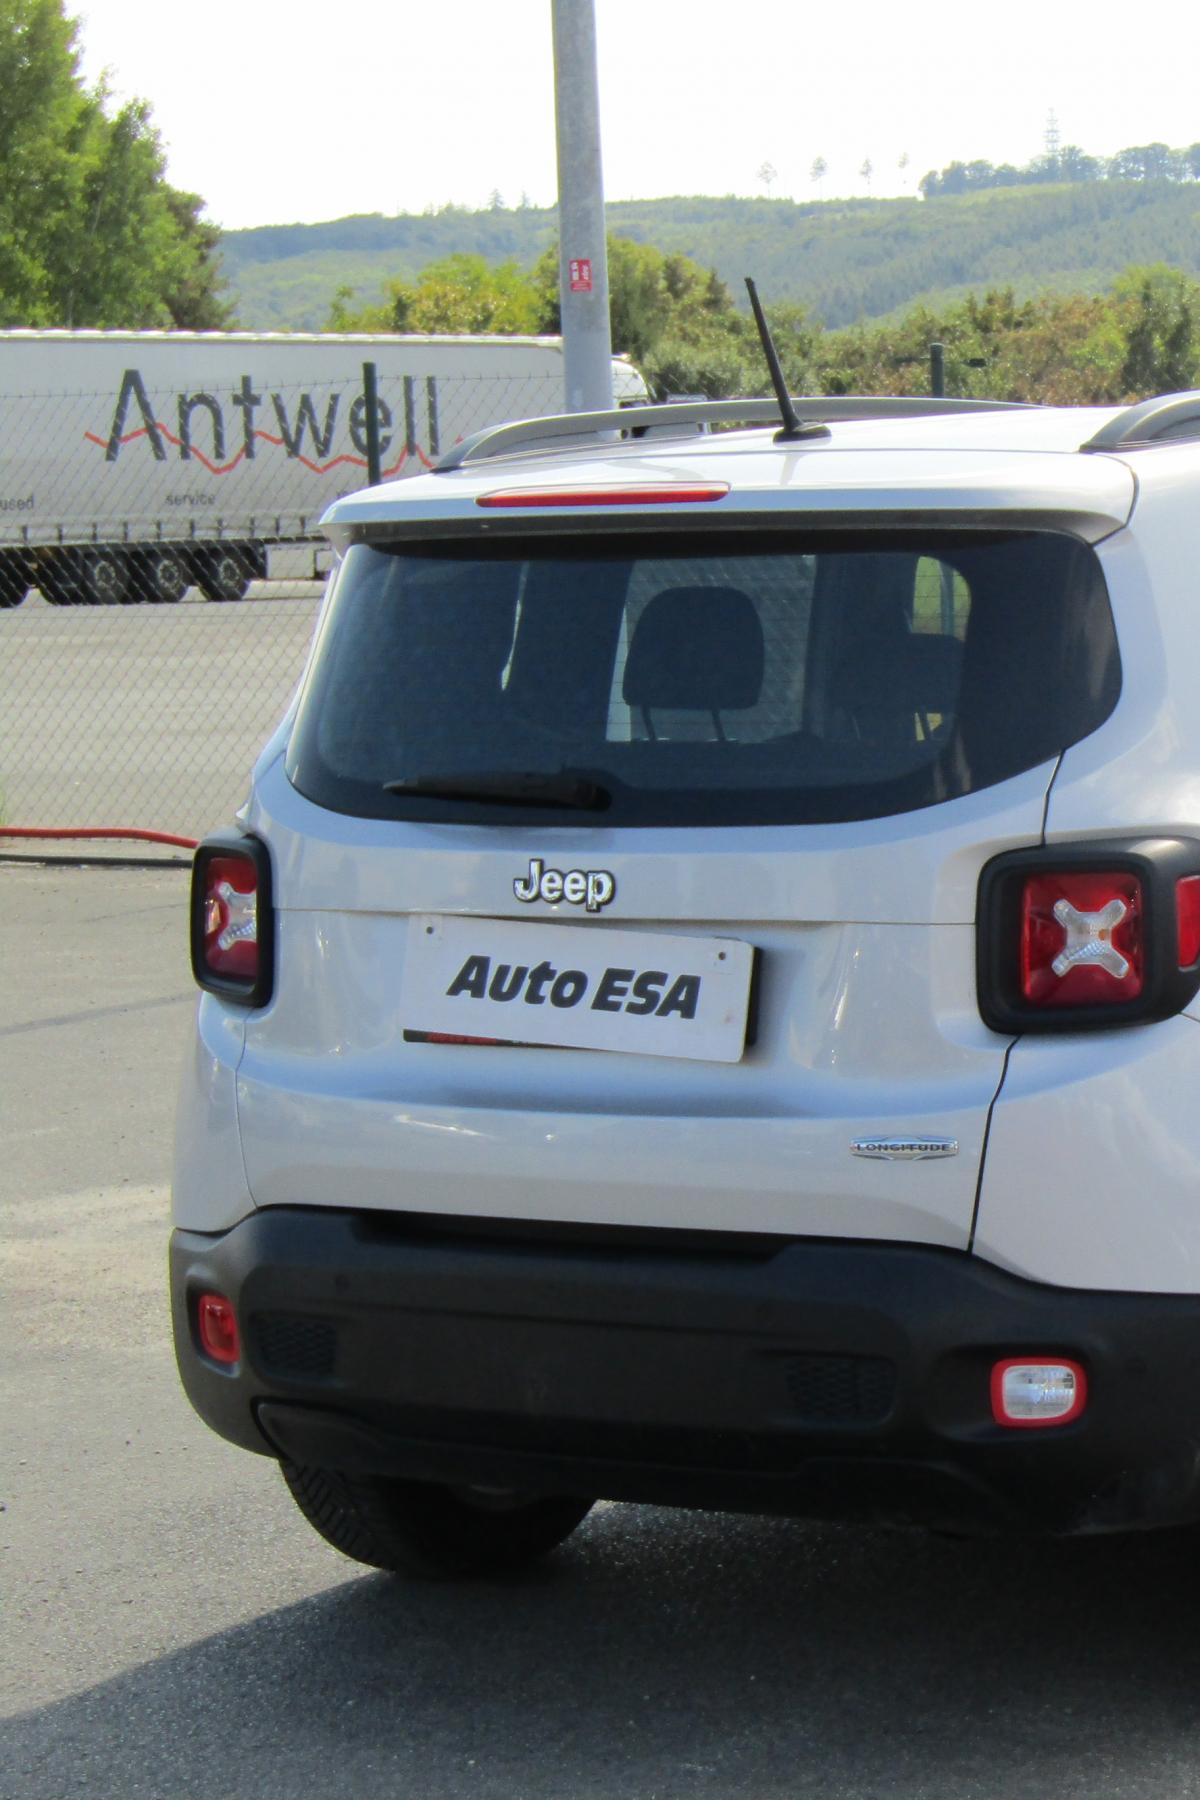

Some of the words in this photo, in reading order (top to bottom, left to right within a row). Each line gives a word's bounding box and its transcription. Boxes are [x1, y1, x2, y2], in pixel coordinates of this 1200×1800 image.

[105, 368, 440, 461] Antwell
[166, 491, 216, 506] service
[513, 859, 616, 912] Jeep
[446, 954, 589, 1008] Auto
[591, 967, 701, 1020] ESA
[856, 1143, 950, 1152] LONGITUDE
